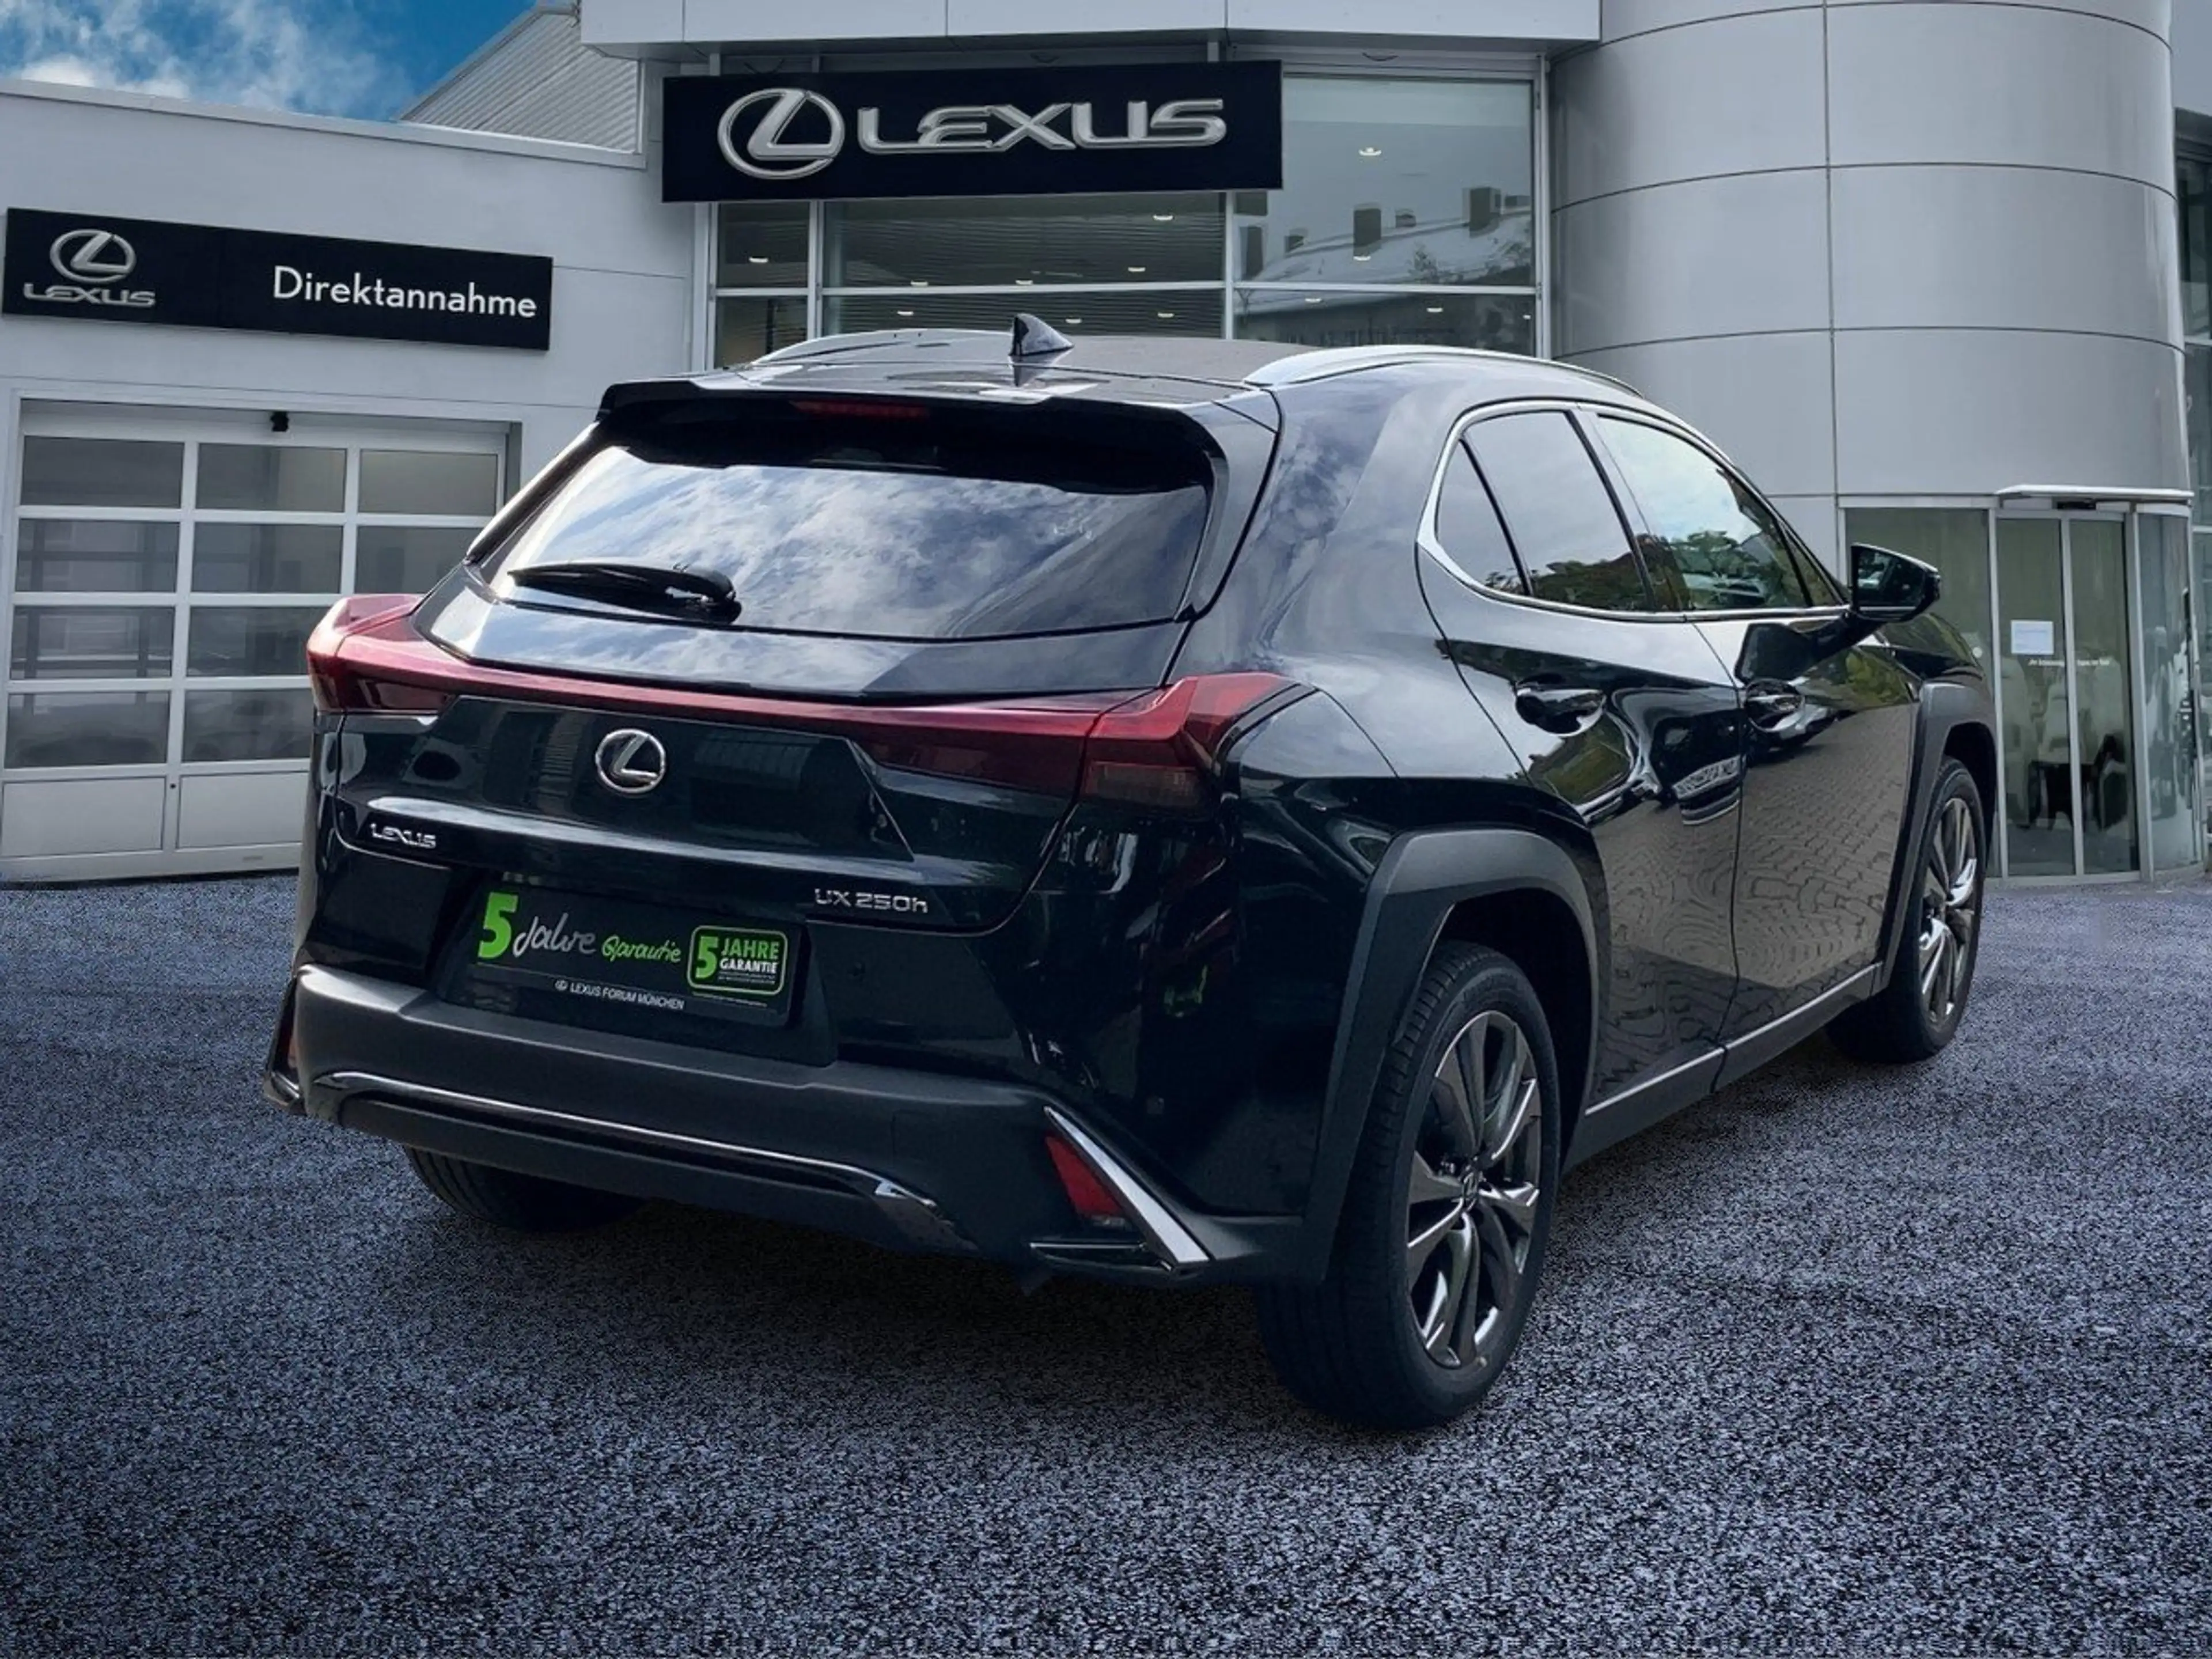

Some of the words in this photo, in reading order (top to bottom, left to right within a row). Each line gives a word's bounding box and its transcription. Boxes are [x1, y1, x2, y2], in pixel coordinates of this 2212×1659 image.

[858, 99, 1226, 154] LEXUS
[23, 282, 156, 308] LEXUS
[274, 265, 537, 318] Direktannahme
[370, 823, 436, 849] LEXUS
[815, 888, 851, 907] UX
[855, 892, 928, 913] 250h
[478, 891, 518, 959] 5
[512, 912, 596, 958] Jahre
[602, 934, 681, 963] Garantie
[695, 935, 718, 979] 5
[721, 938, 780, 960] JAHRE
[719, 957, 778, 974] GARANTIE
[569, 982, 601, 997] LEXUS
[603, 988, 637, 1002] FORUM
